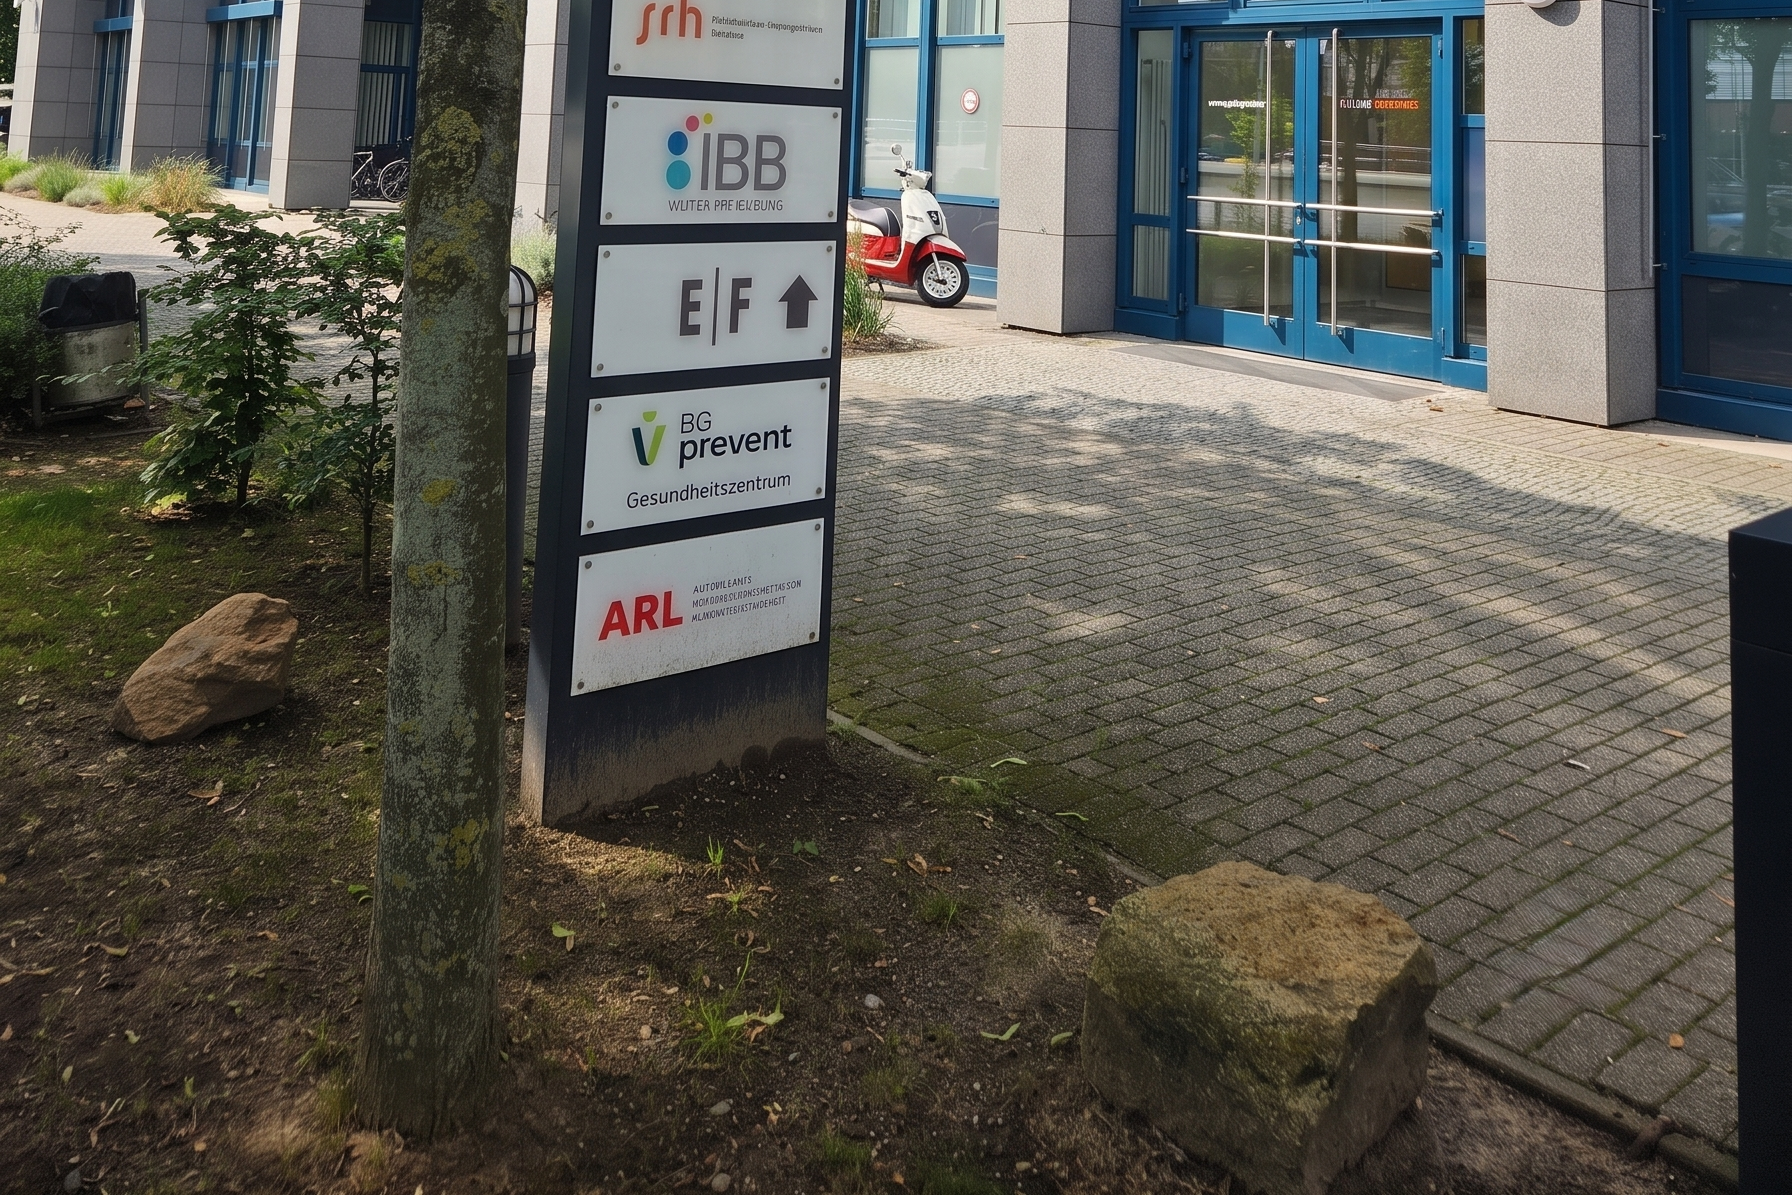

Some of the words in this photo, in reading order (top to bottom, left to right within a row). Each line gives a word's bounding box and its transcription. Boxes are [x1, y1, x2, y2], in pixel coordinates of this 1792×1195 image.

[699, 132, 788, 192] IBB
[680, 411, 712, 434] BG
[678, 424, 793, 469] prevent
[626, 474, 791, 509] Gesundheitszentrum
[597, 590, 684, 641] ARL
